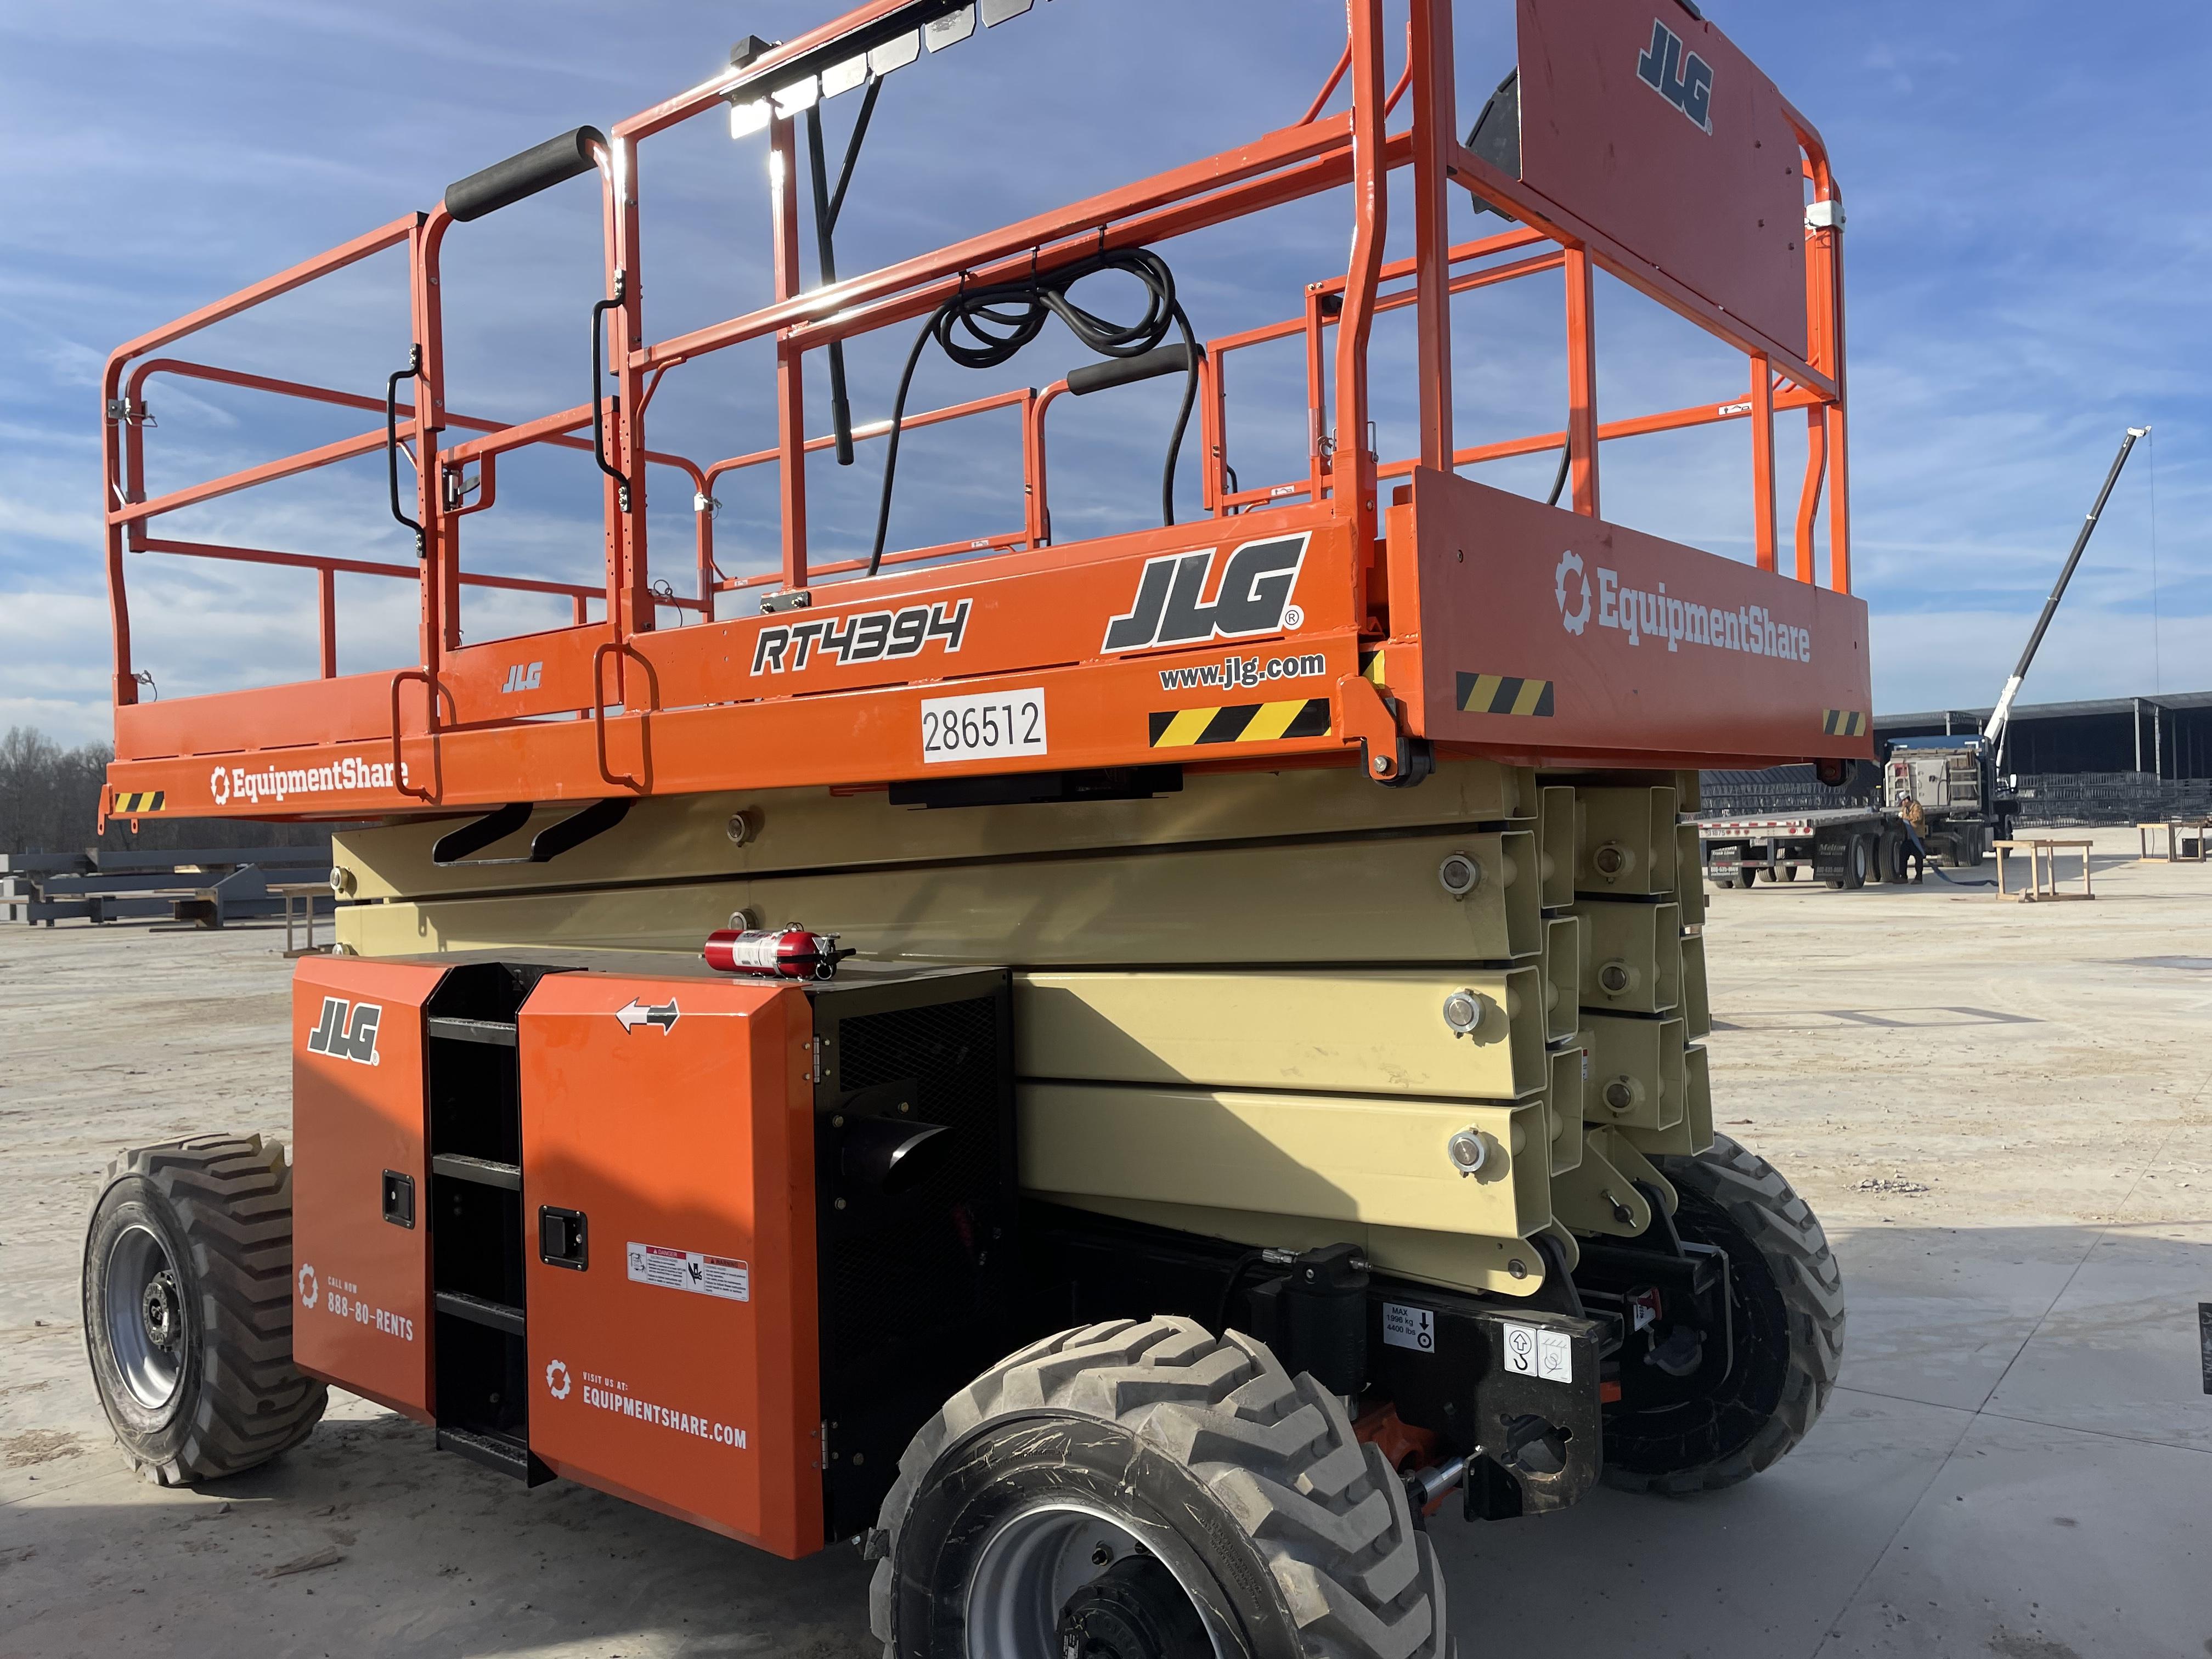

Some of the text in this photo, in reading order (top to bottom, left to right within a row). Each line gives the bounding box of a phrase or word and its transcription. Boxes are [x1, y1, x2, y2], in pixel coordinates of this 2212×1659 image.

[1637, 18, 1713, 132] JLG
[1099, 531, 1312, 654] JLG
[1597, 567, 1810, 662] EquipmentShare
[750, 598, 973, 676] RT4394
[501, 661, 543, 693] JLG
[1159, 653, 1325, 691] www.jlg.com
[922, 702, 1041, 752] 286512
[232, 757, 408, 803] EquipmentShare
[307, 996, 382, 1065] JLG
[658, 1249, 678, 1257] DANGER
[716, 1259, 738, 1268] WARNING
[328, 1276, 357, 1294] CALL NOW
[328, 1292, 413, 1341] 888-80-RENTS
[1387, 1314, 1413, 1327] 1996 kg
[1387, 1324, 1403, 1333] 4400
[1392, 1307, 1408, 1316] MAX
[583, 1372, 628, 1391] VISIT US AT:
[583, 1385, 746, 1449] EQUIPMENTSHARE.COM
